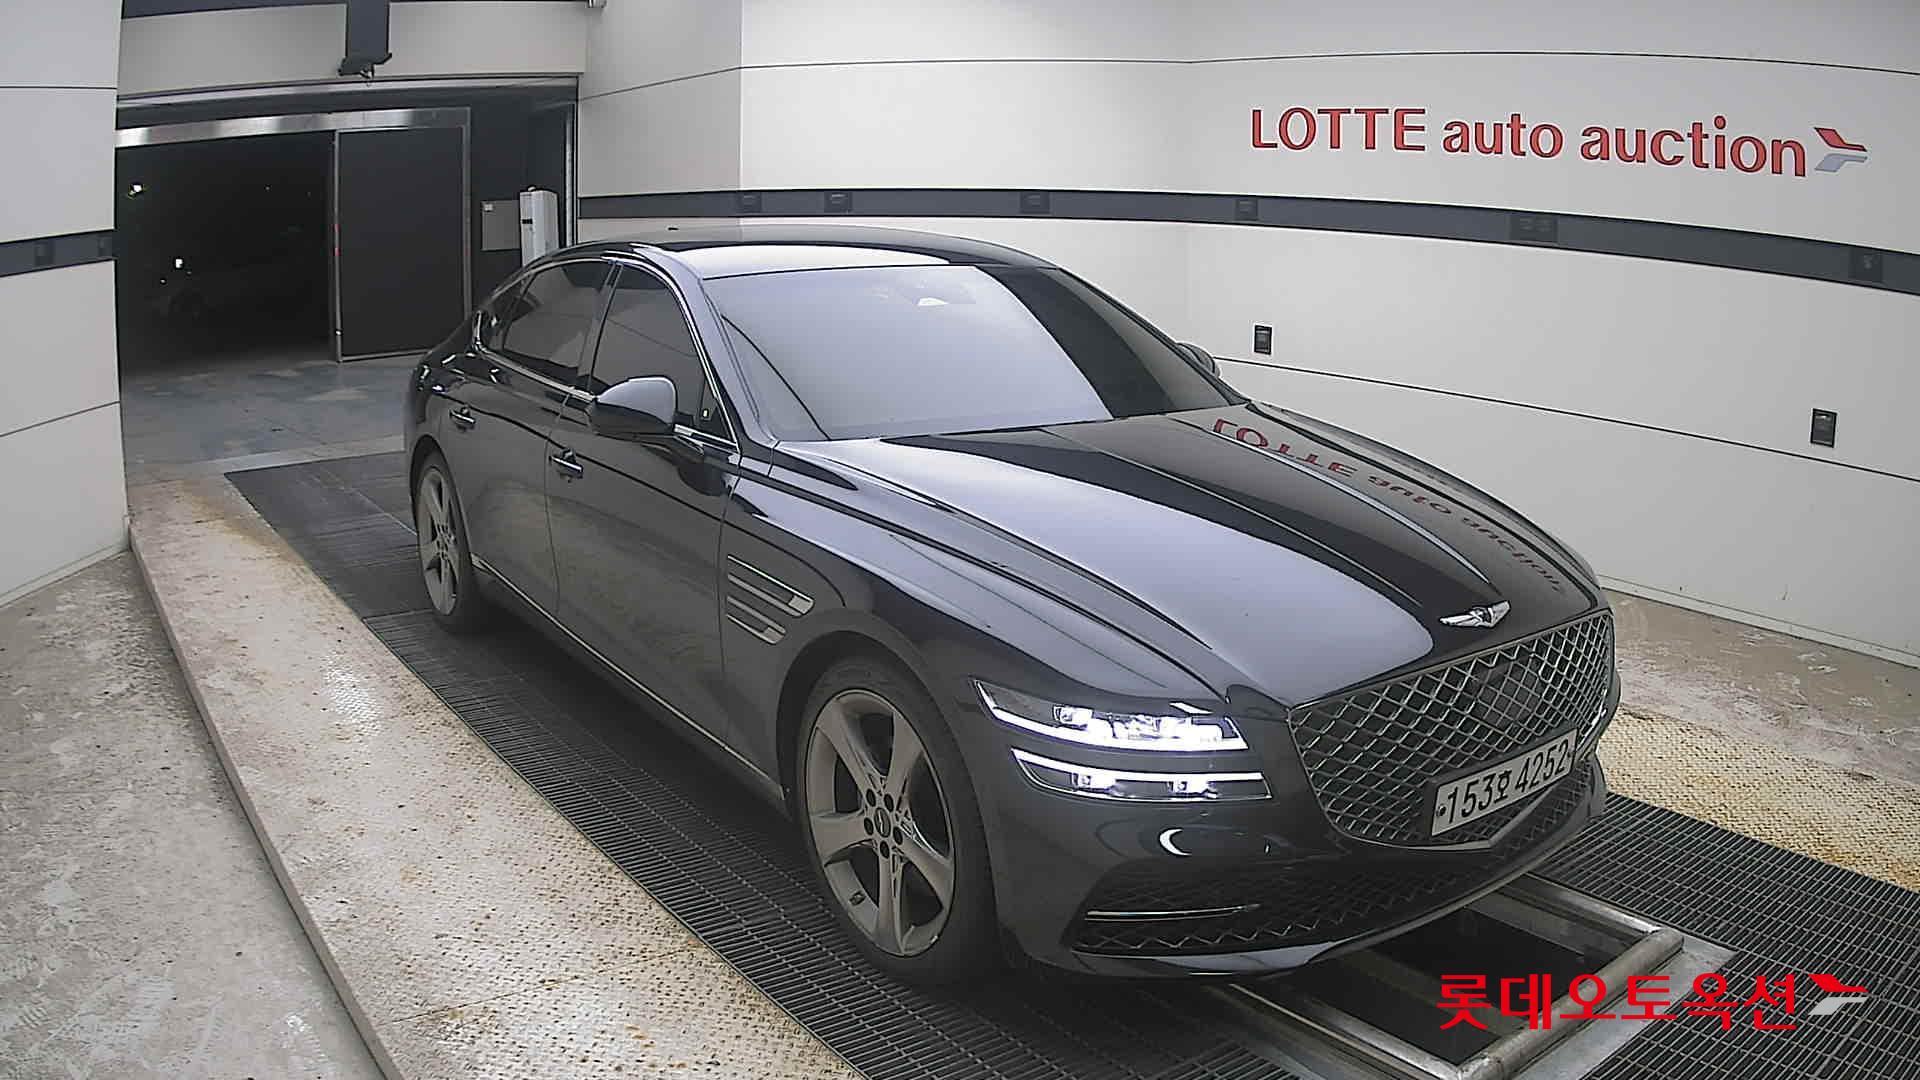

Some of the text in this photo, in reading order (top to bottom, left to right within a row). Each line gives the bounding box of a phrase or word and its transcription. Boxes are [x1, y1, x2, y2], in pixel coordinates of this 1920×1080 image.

[1251, 107, 1807, 177] LOTTE auto auction
[1448, 739, 1569, 823] 153호 4252
